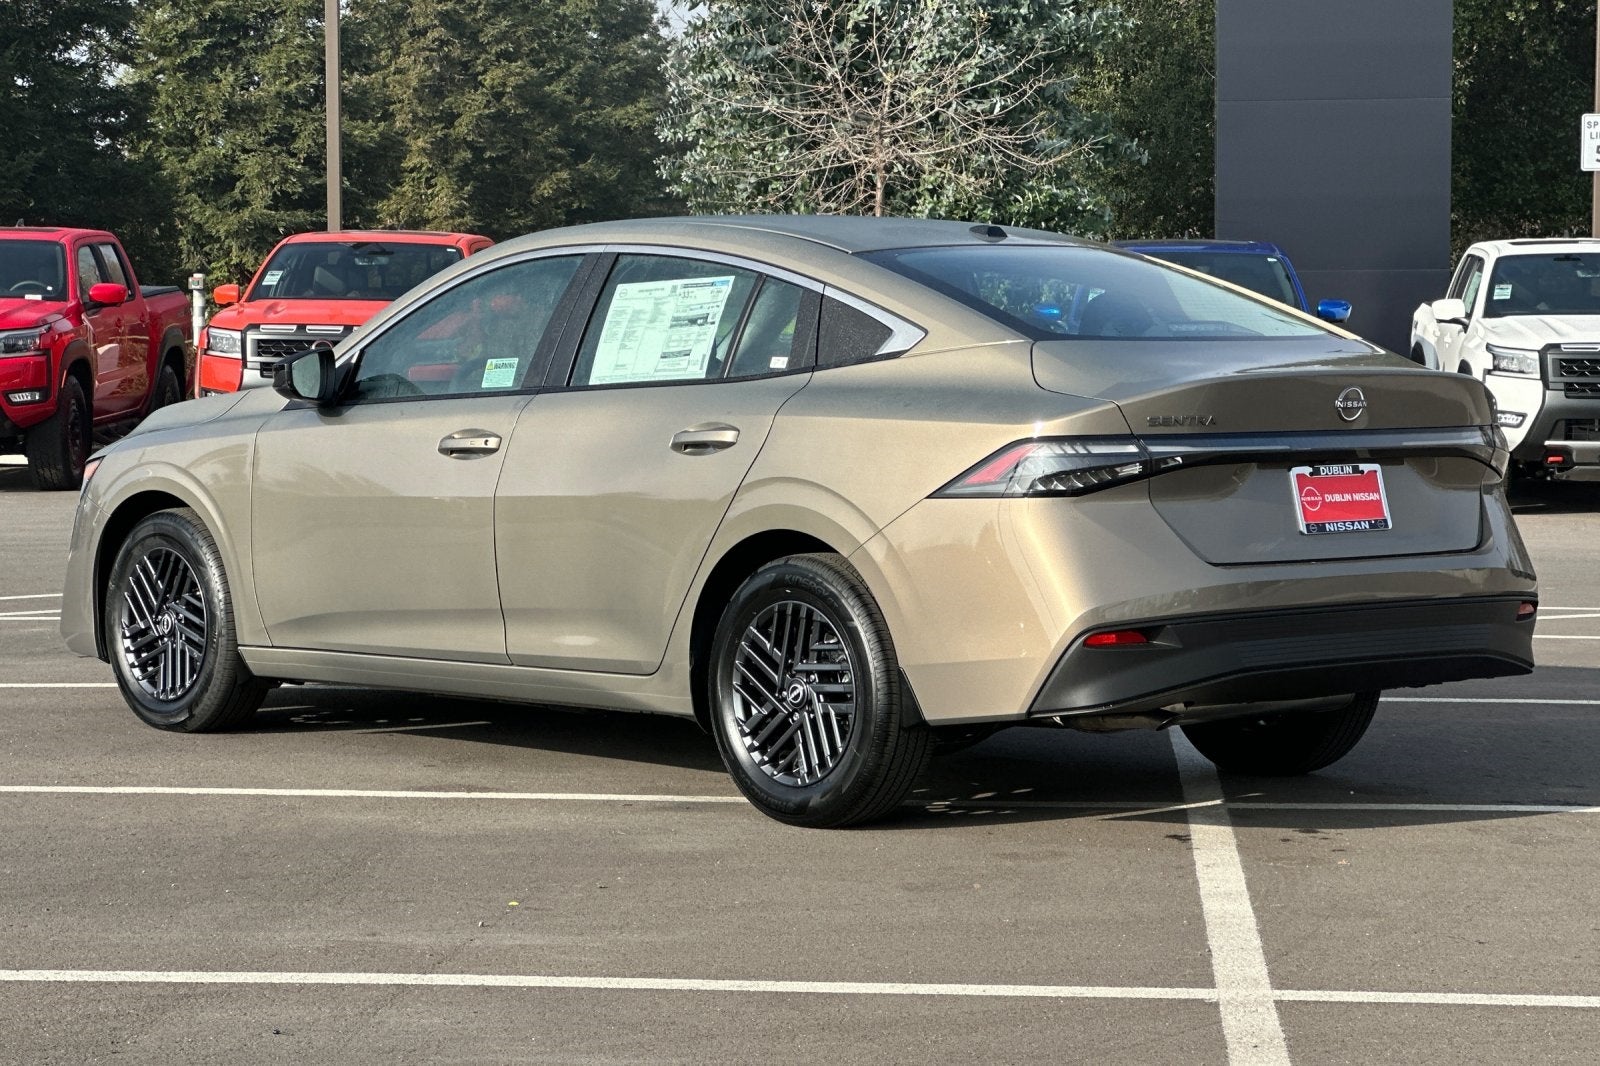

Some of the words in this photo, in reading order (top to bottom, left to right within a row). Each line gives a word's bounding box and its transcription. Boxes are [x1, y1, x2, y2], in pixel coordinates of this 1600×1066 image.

[1590, 131, 1600, 140] LI
[1335, 400, 1367, 408] NISSAN
[1147, 415, 1217, 427] SENTRA
[1320, 465, 1353, 476] DUBLIN
[1324, 493, 1352, 503] DUBLIN
[1352, 492, 1380, 502] NISSAN
[1325, 521, 1370, 532] NISSAN
